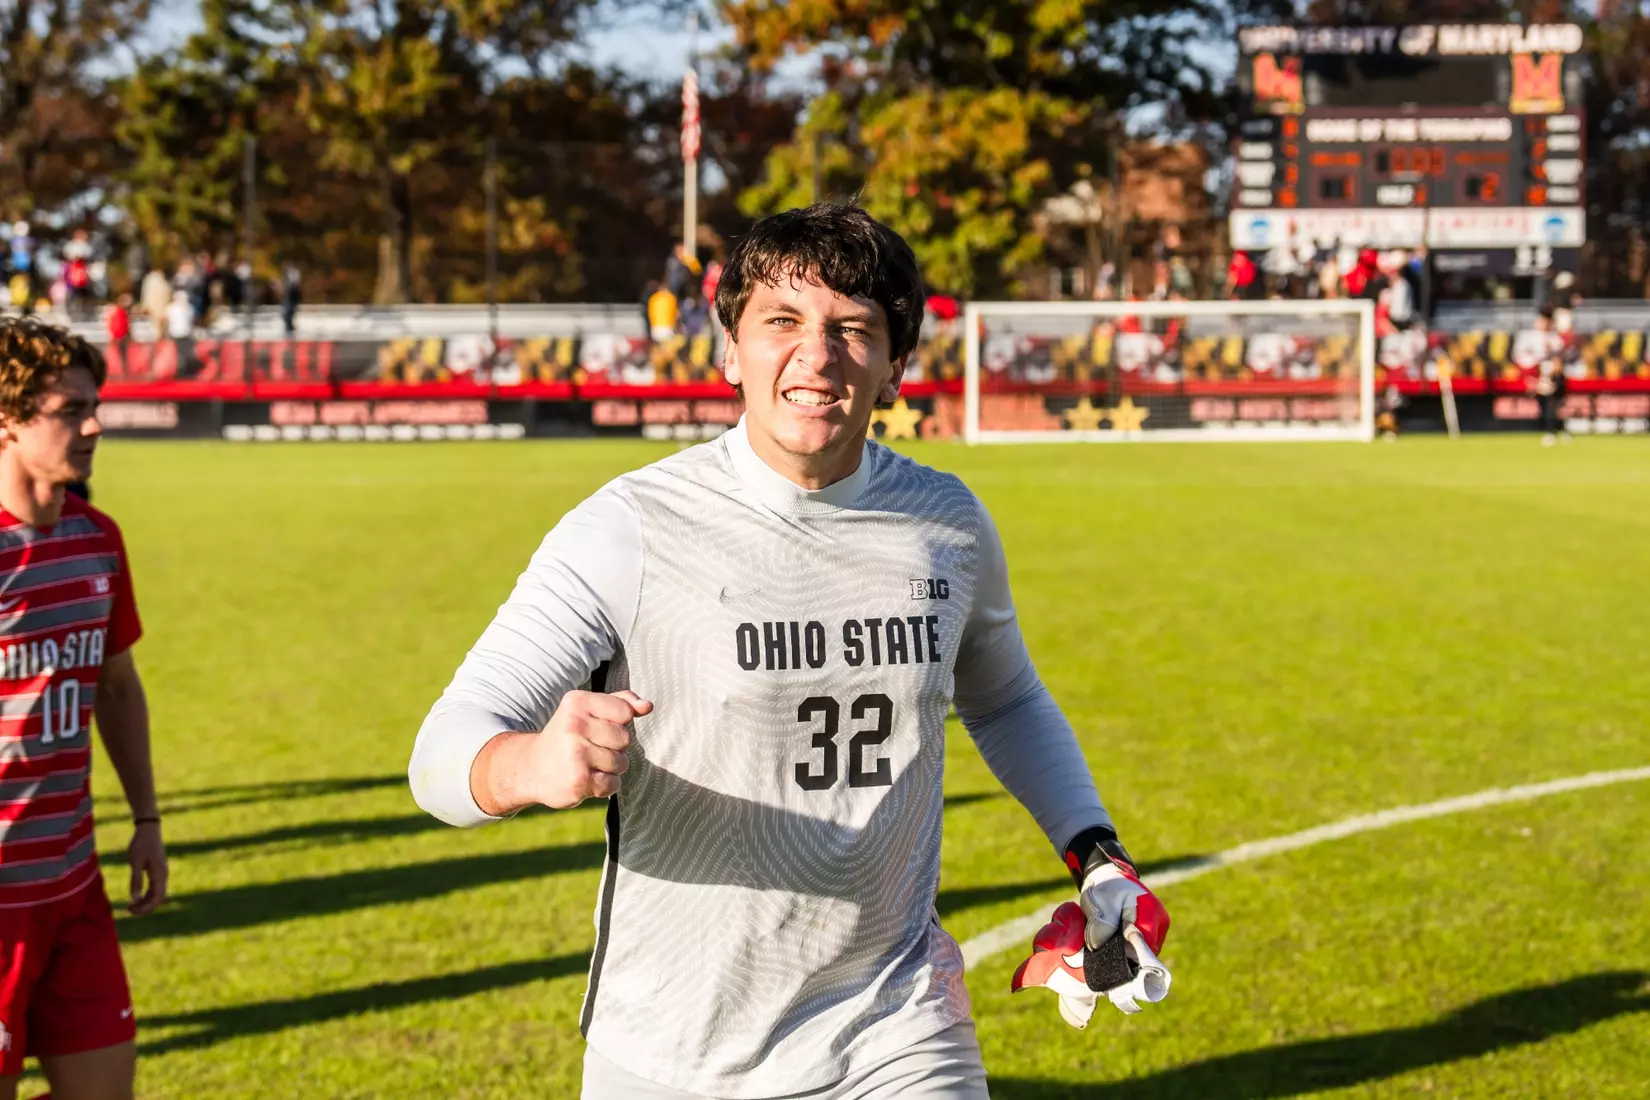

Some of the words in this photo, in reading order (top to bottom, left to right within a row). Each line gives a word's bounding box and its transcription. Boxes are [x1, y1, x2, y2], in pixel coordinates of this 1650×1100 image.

[1239, 26, 1396, 54] UNIVERSITY
[1399, 25, 1436, 55] OF
[1437, 24, 1583, 55] MARYLAND
[62, 628, 107, 669] STA
[736, 620, 827, 671] OHIO
[842, 615, 941, 667] STATE
[40, 678, 80, 744] 10
[795, 693, 894, 791] 32
